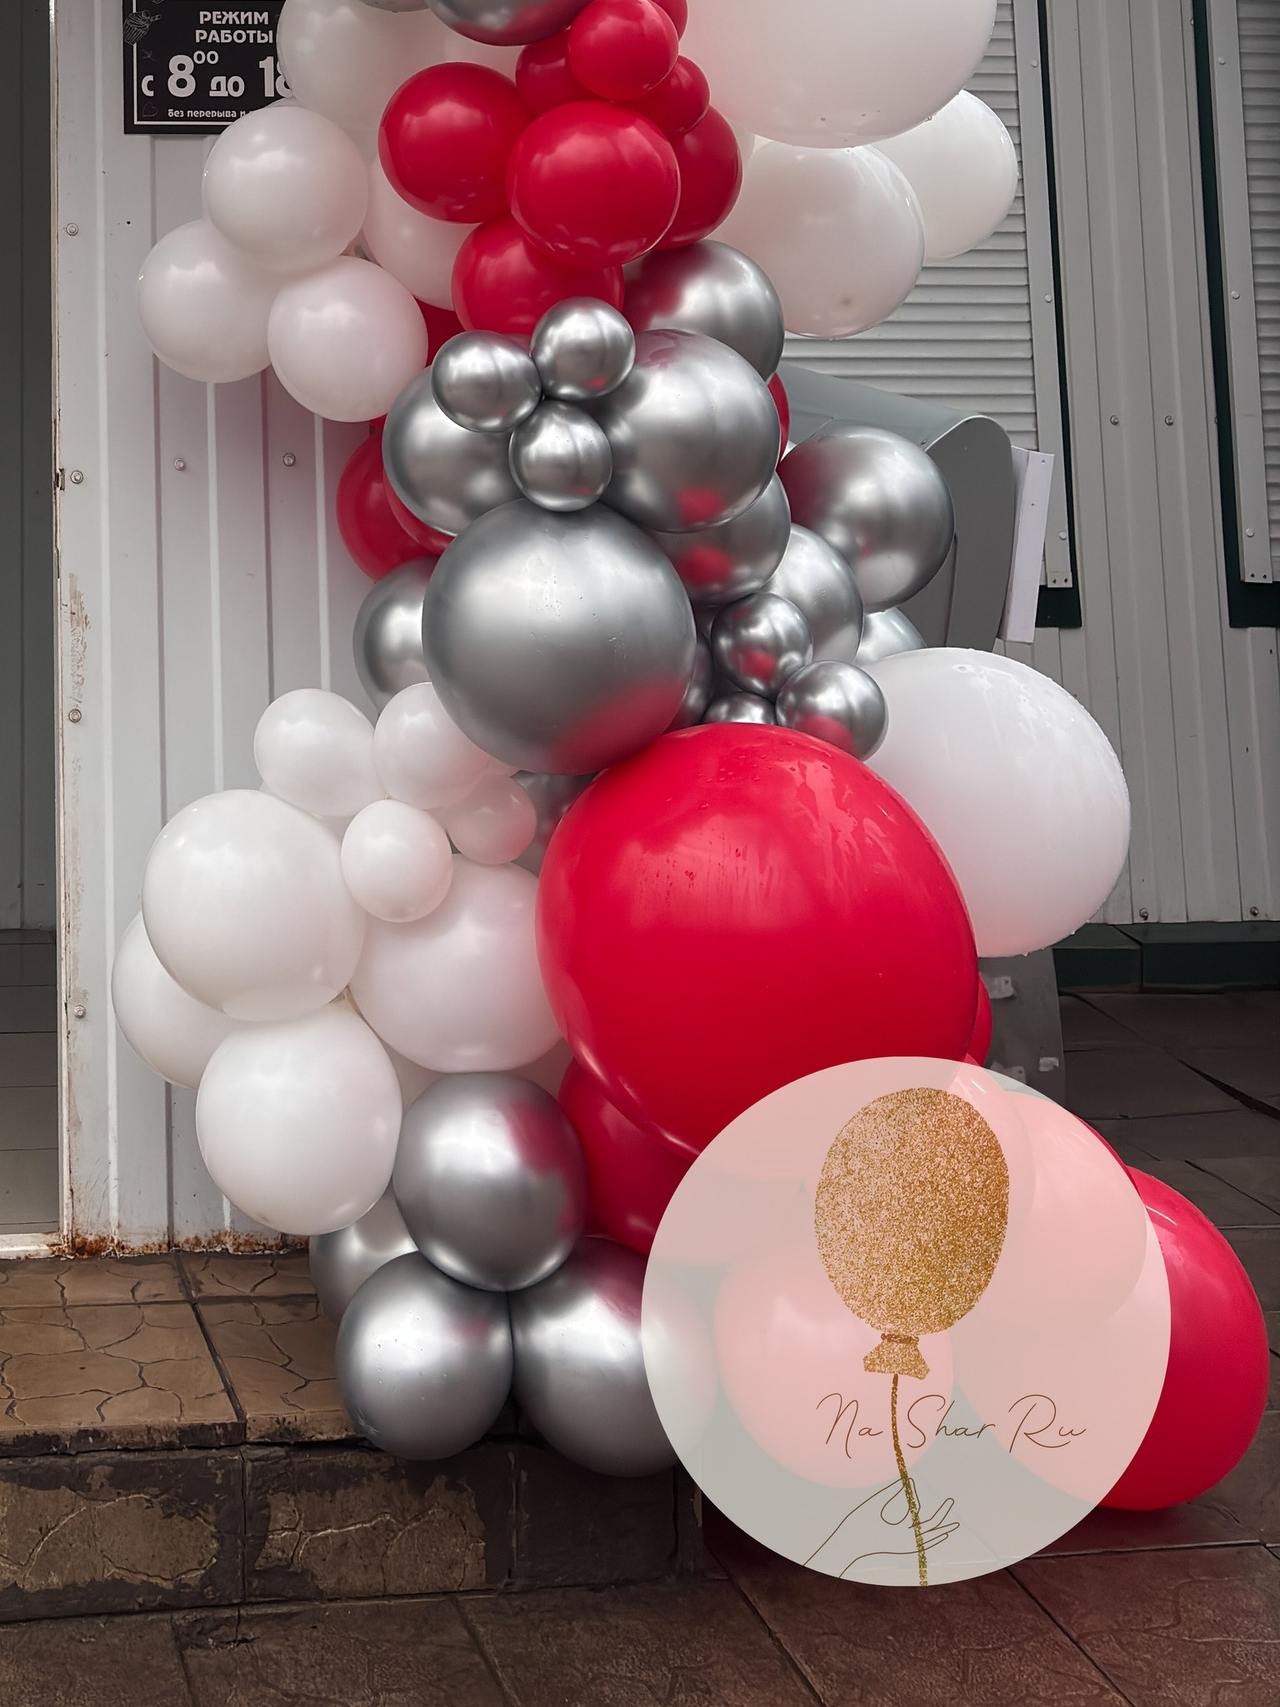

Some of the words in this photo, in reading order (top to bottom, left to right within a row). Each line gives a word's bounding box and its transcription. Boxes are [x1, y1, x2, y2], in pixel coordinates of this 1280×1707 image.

[199, 11, 269, 25] РЕЖИМ
[195, 29, 273, 43] РАБОТЫ
[209, 75, 246, 98] до
[167, 108, 185, 118] без
[187, 110, 237, 118] перерыва
